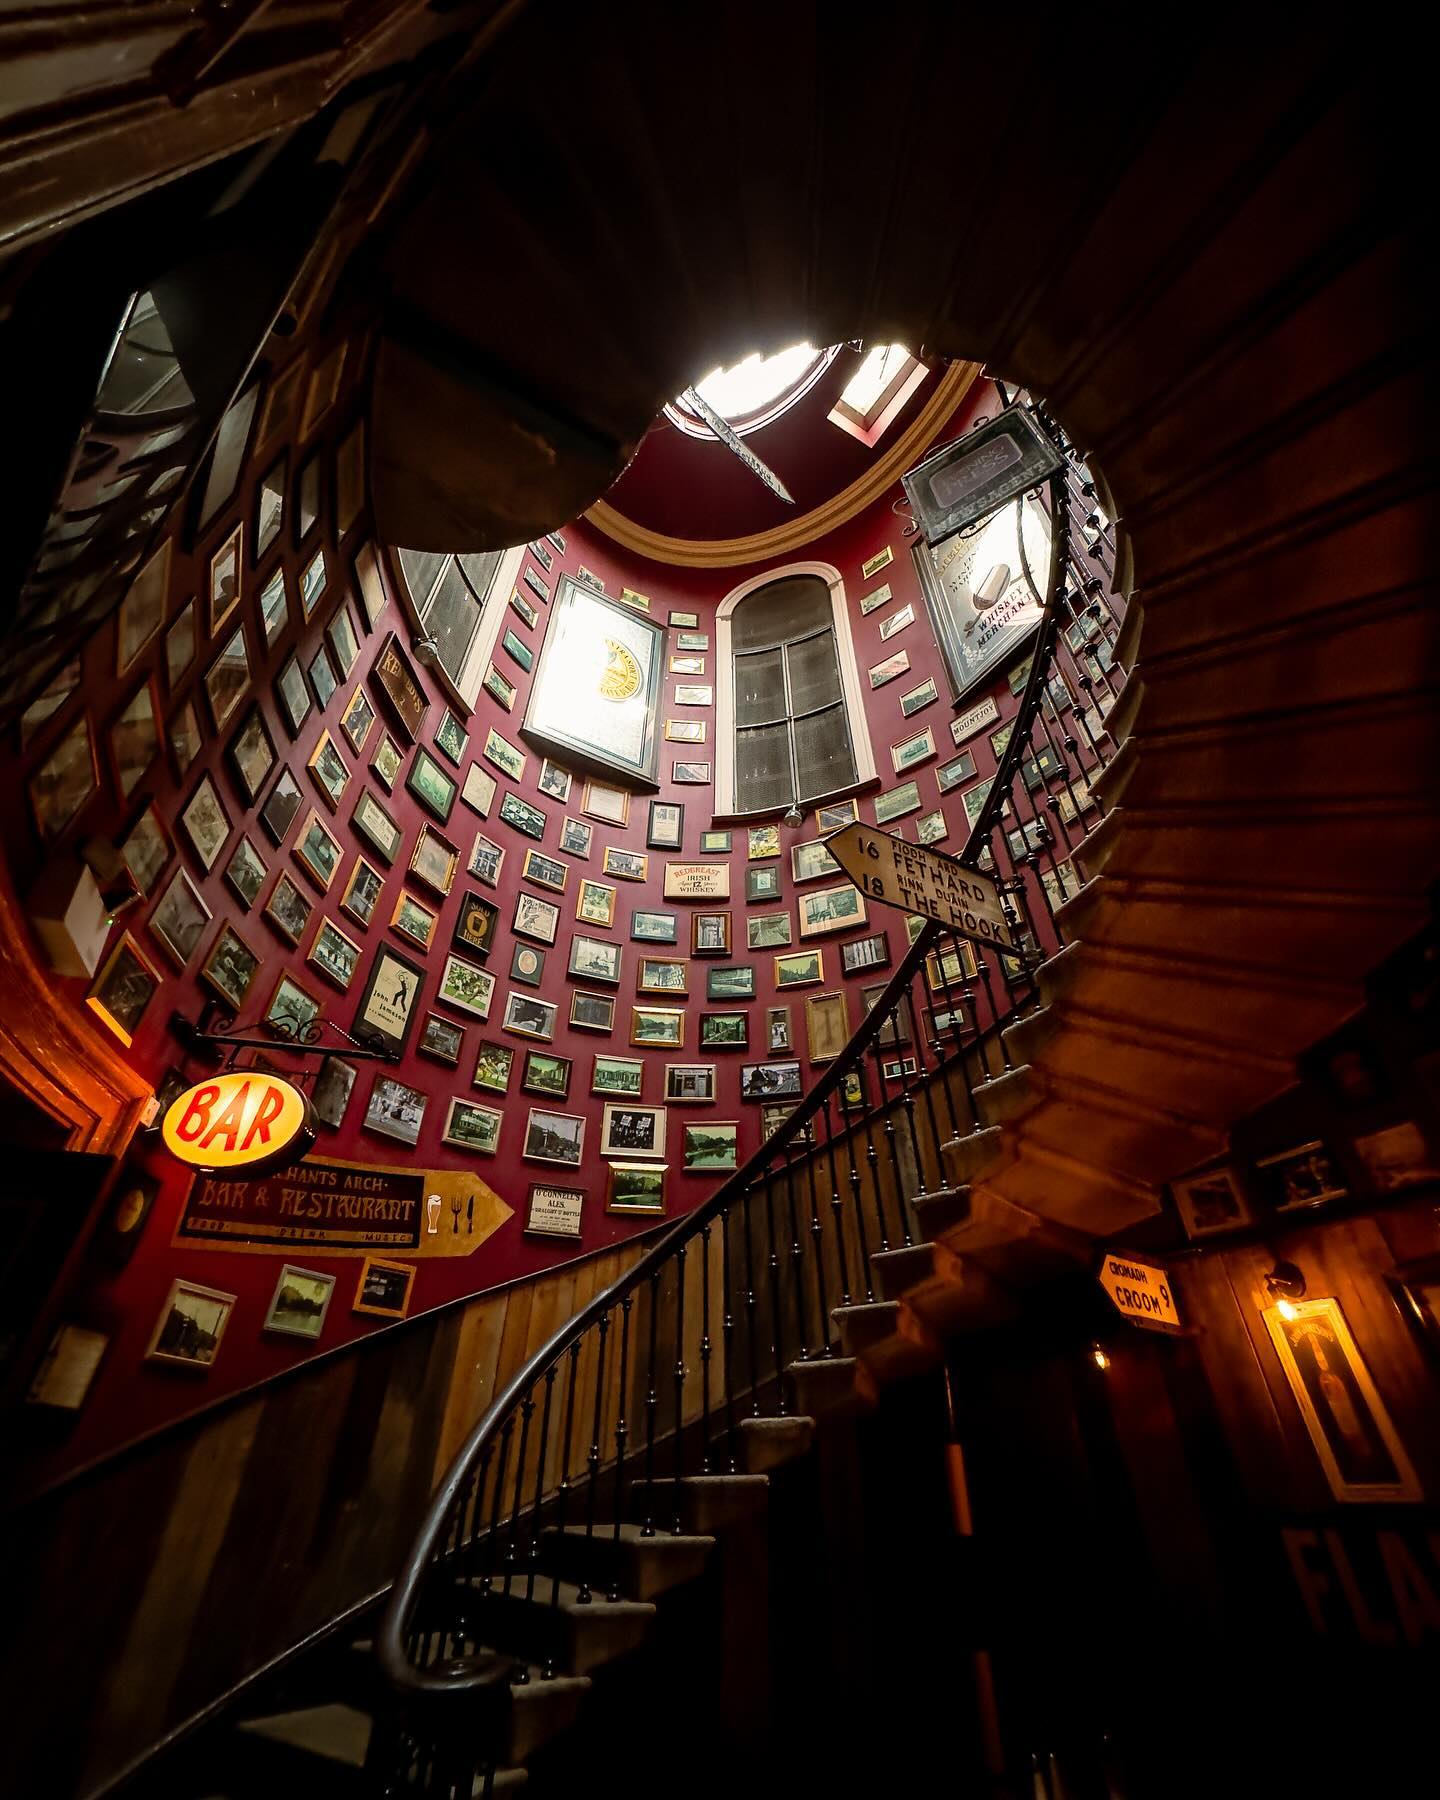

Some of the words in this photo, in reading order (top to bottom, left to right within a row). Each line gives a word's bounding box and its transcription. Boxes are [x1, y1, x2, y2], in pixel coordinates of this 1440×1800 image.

[976, 592, 1034, 648] MERCHANT
[978, 586, 1023, 632] WHISKEY
[953, 704, 994, 735] MOUNTJOY
[858, 836, 879, 859] 16
[891, 841, 926, 862] FIODH
[937, 860, 958, 876] ARD
[673, 866, 721, 878] REDBREAST
[863, 873, 884, 896] 18
[893, 852, 985, 902] FETHARD
[897, 874, 924, 892] RINN
[471, 903, 490, 917] SOLD
[899, 887, 940, 918] THE
[950, 906, 1005, 943] HOOK
[463, 929, 484, 946] HERE
[175, 1081, 285, 1151] BAR
[274, 1165, 337, 1187] HANTS
[198, 1179, 250, 1208] BAR
[254, 1185, 270, 1207] &
[279, 1187, 416, 1222] RESTAURANT
[536, 1189, 580, 1201] O'CONNELL'S
[1109, 1262, 1148, 1284] CROMADH
[1115, 1286, 1163, 1316] CROOM
[1159, 1284, 1170, 1308] 9
